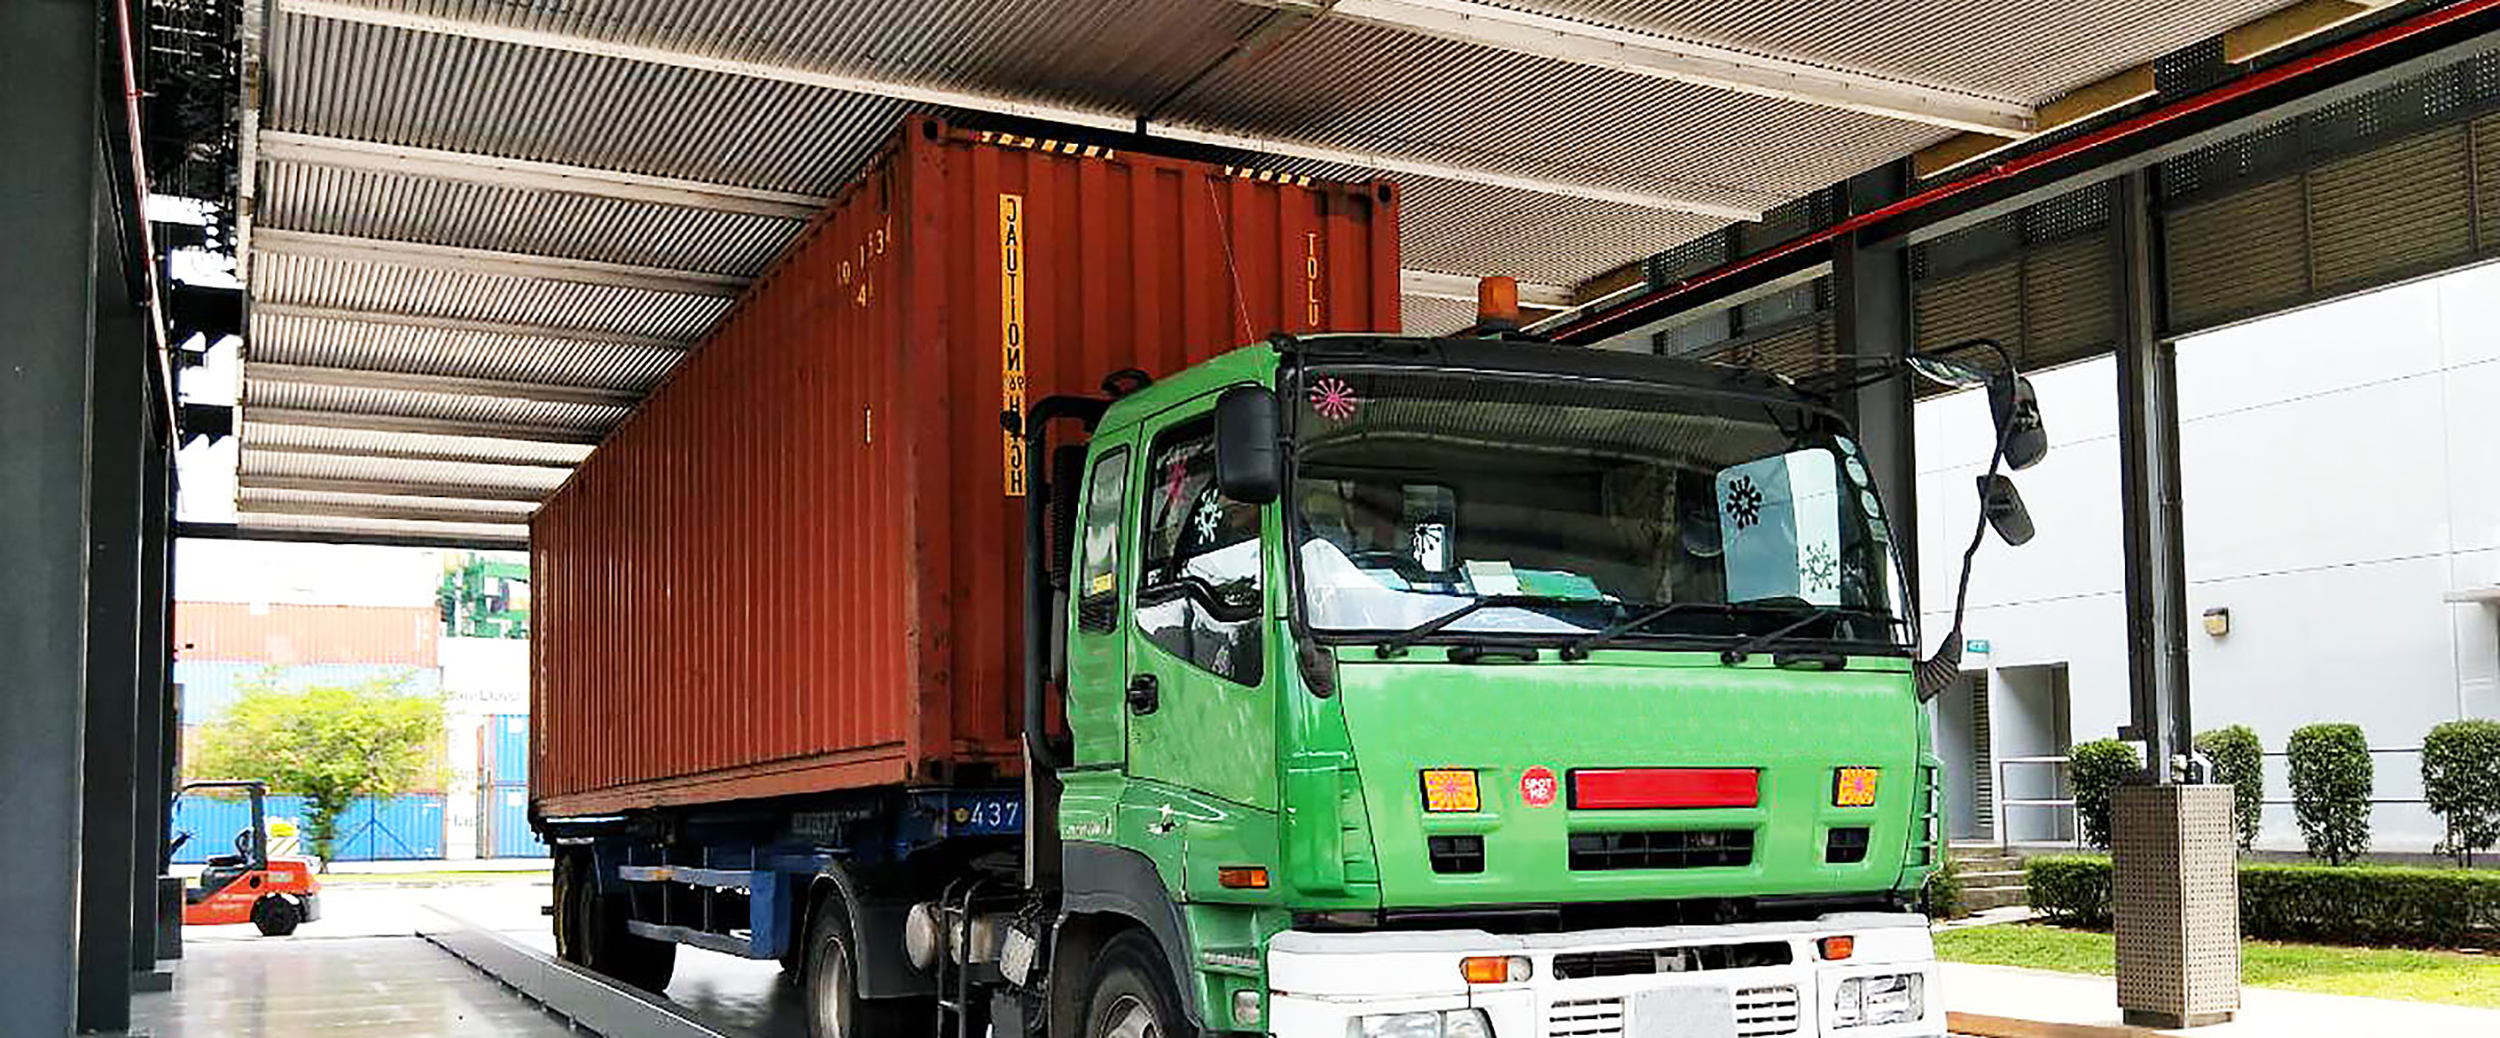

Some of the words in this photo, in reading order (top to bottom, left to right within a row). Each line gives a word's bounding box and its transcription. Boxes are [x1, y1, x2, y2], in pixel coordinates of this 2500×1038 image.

[1307, 233, 1319, 326] TOLU
[1524, 778, 1552, 789] SPOT
[970, 802, 1018, 827] 437
